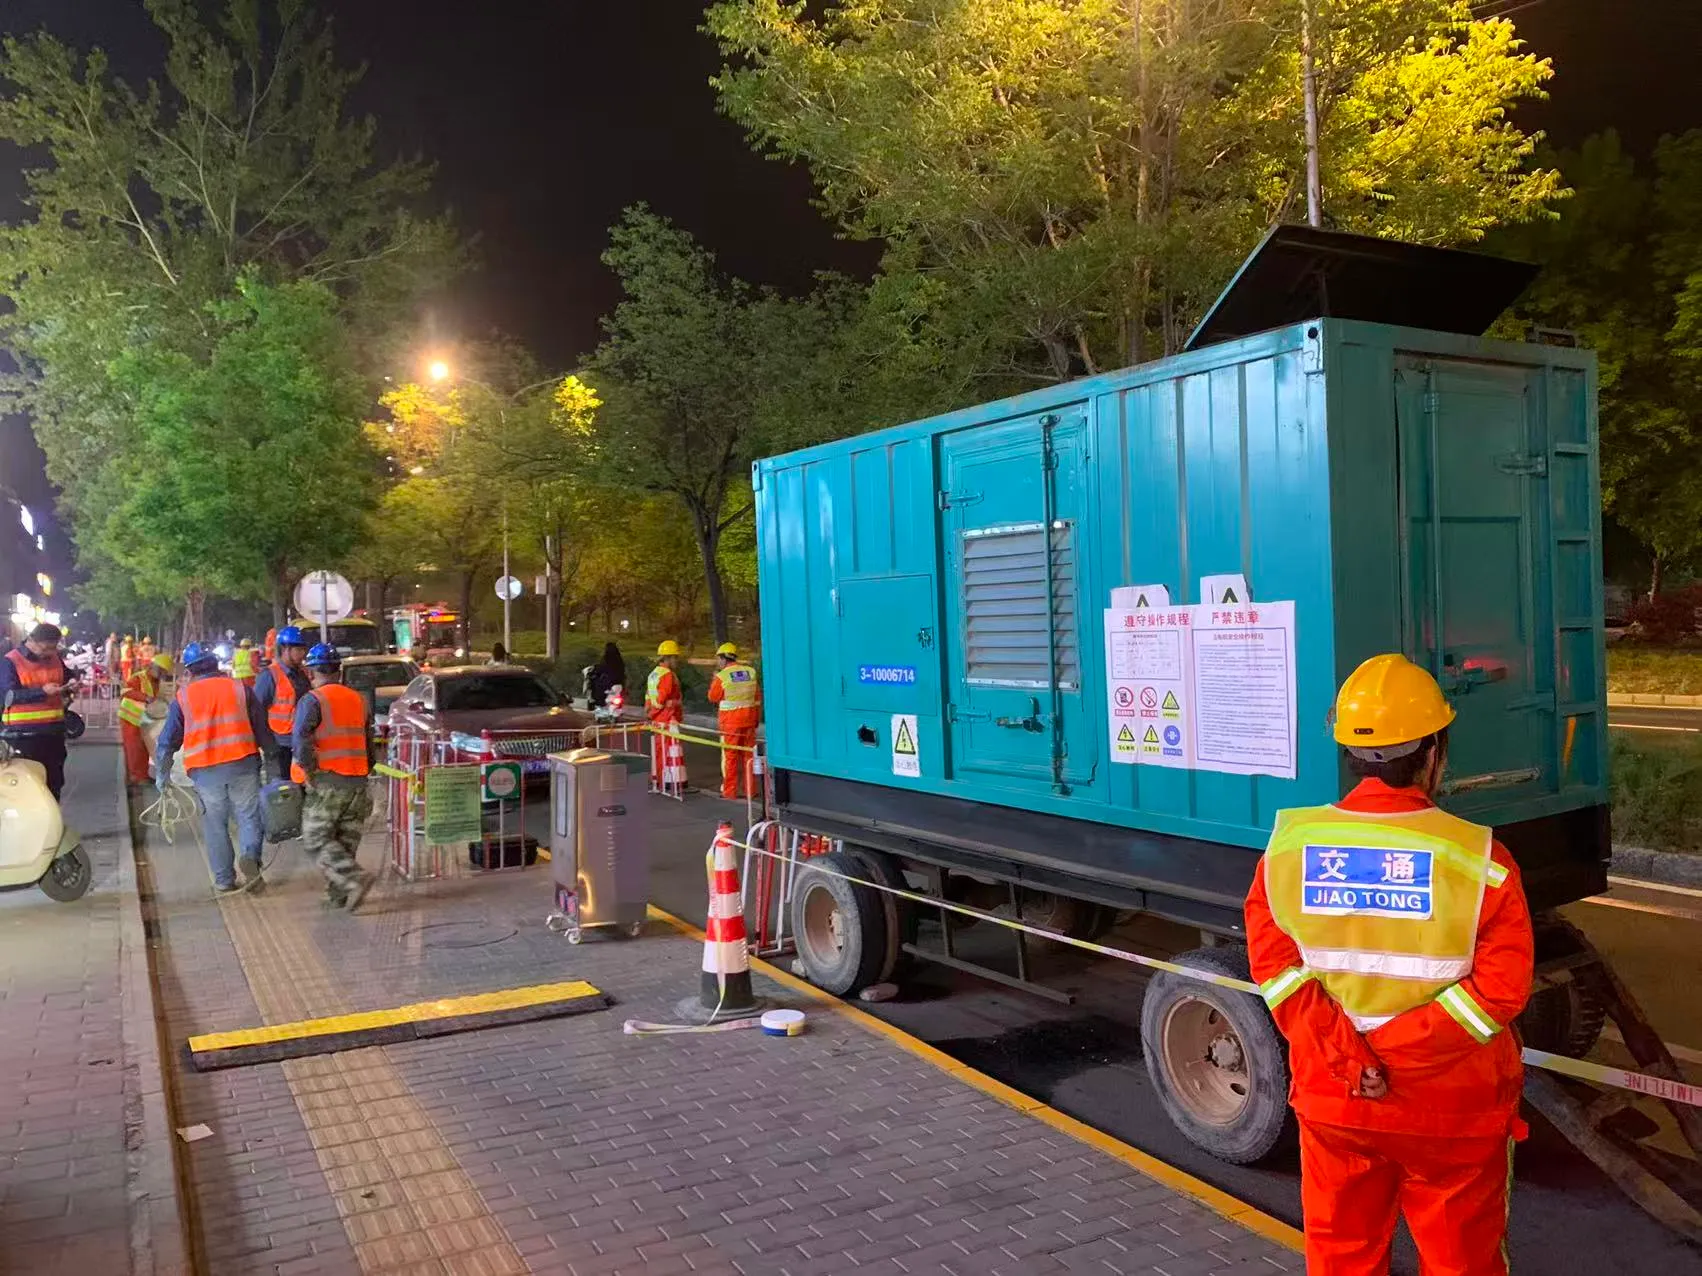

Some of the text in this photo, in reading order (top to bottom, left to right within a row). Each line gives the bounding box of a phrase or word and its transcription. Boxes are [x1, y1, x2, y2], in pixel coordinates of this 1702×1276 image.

[1124, 612, 1190, 628] 遵守操作规程
[1212, 611, 1260, 625] 严禁违章
[860, 667, 915, 682] 3-10006714
[1318, 849, 1415, 884] 交通
[1313, 889, 1422, 909] JIAO TONG
